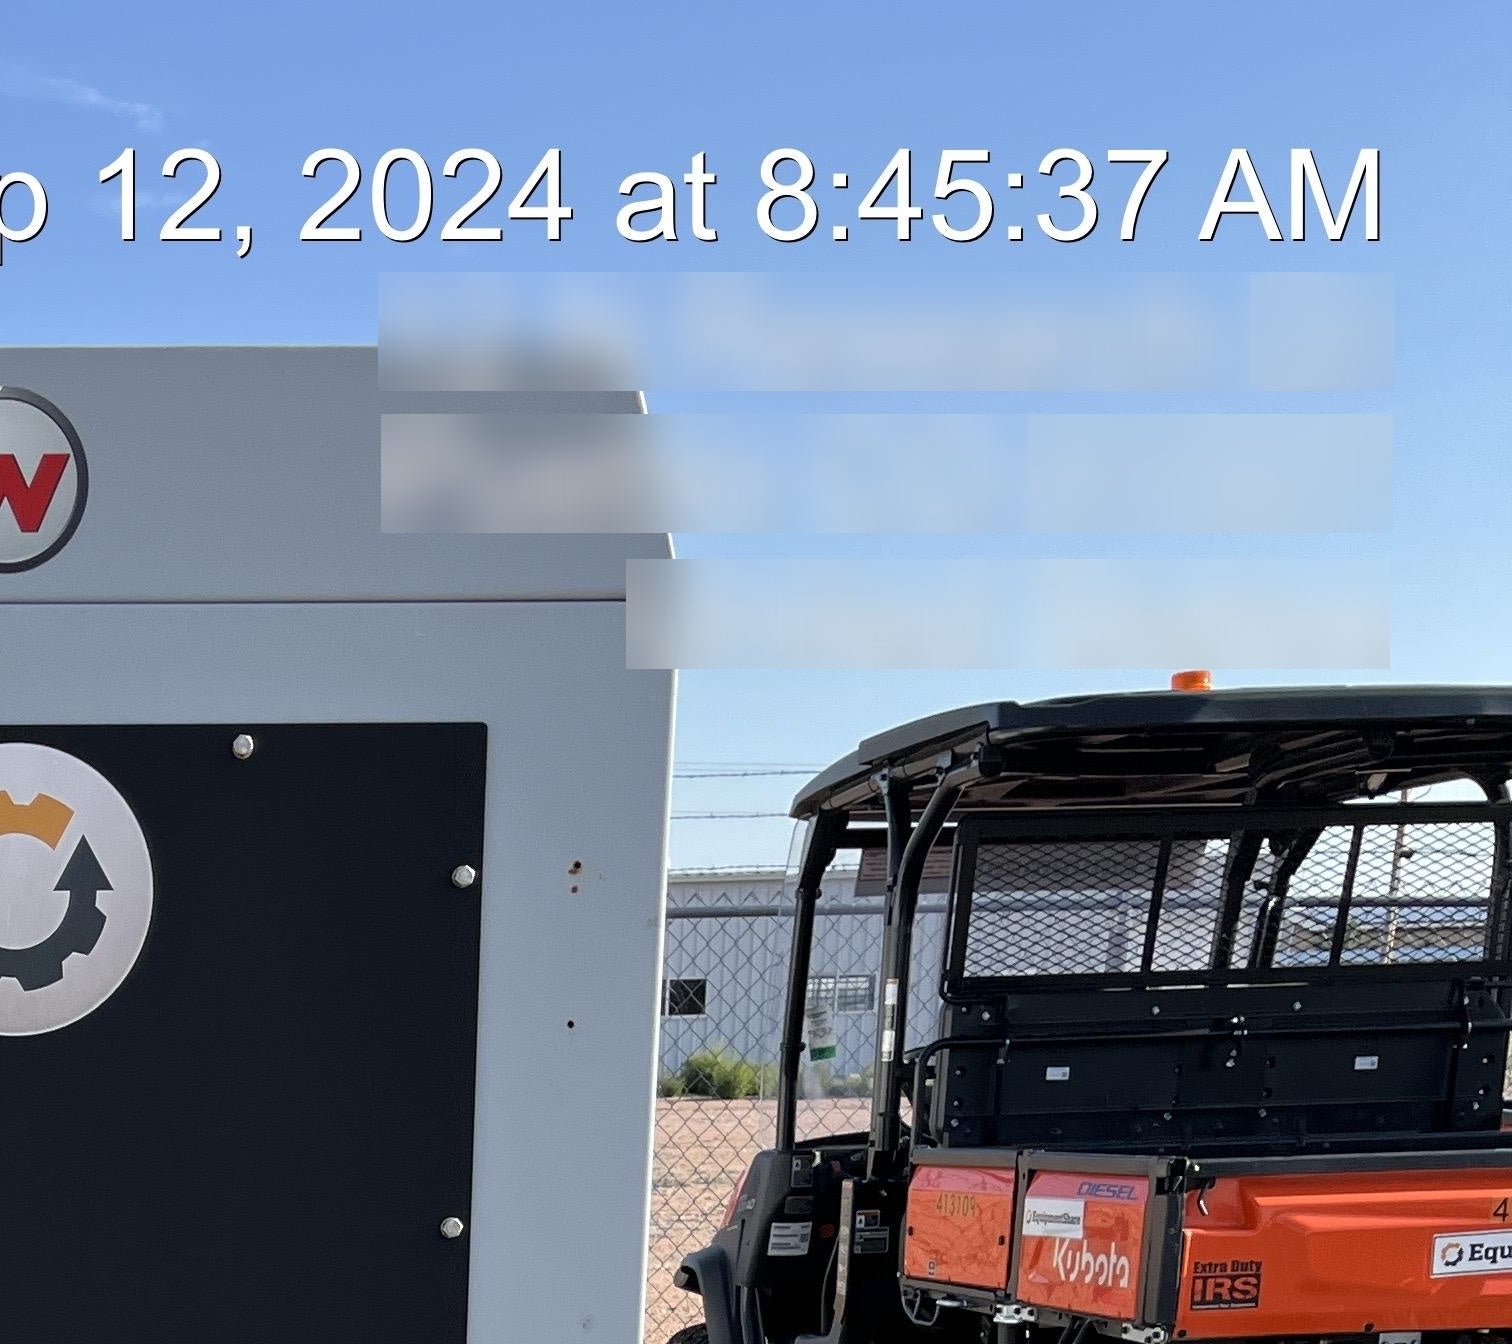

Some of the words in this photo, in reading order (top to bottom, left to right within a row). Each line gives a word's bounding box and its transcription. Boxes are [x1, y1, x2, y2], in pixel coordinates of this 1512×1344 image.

[1076, 1181, 1137, 1200] DIESEL
[1492, 1197, 1510, 1222] 4
[1053, 1238, 1130, 1288] Kubota
[1193, 1262, 1228, 1274] Extra
[1230, 1260, 1262, 1273] Duty
[1193, 1276, 1258, 1302] IRS
